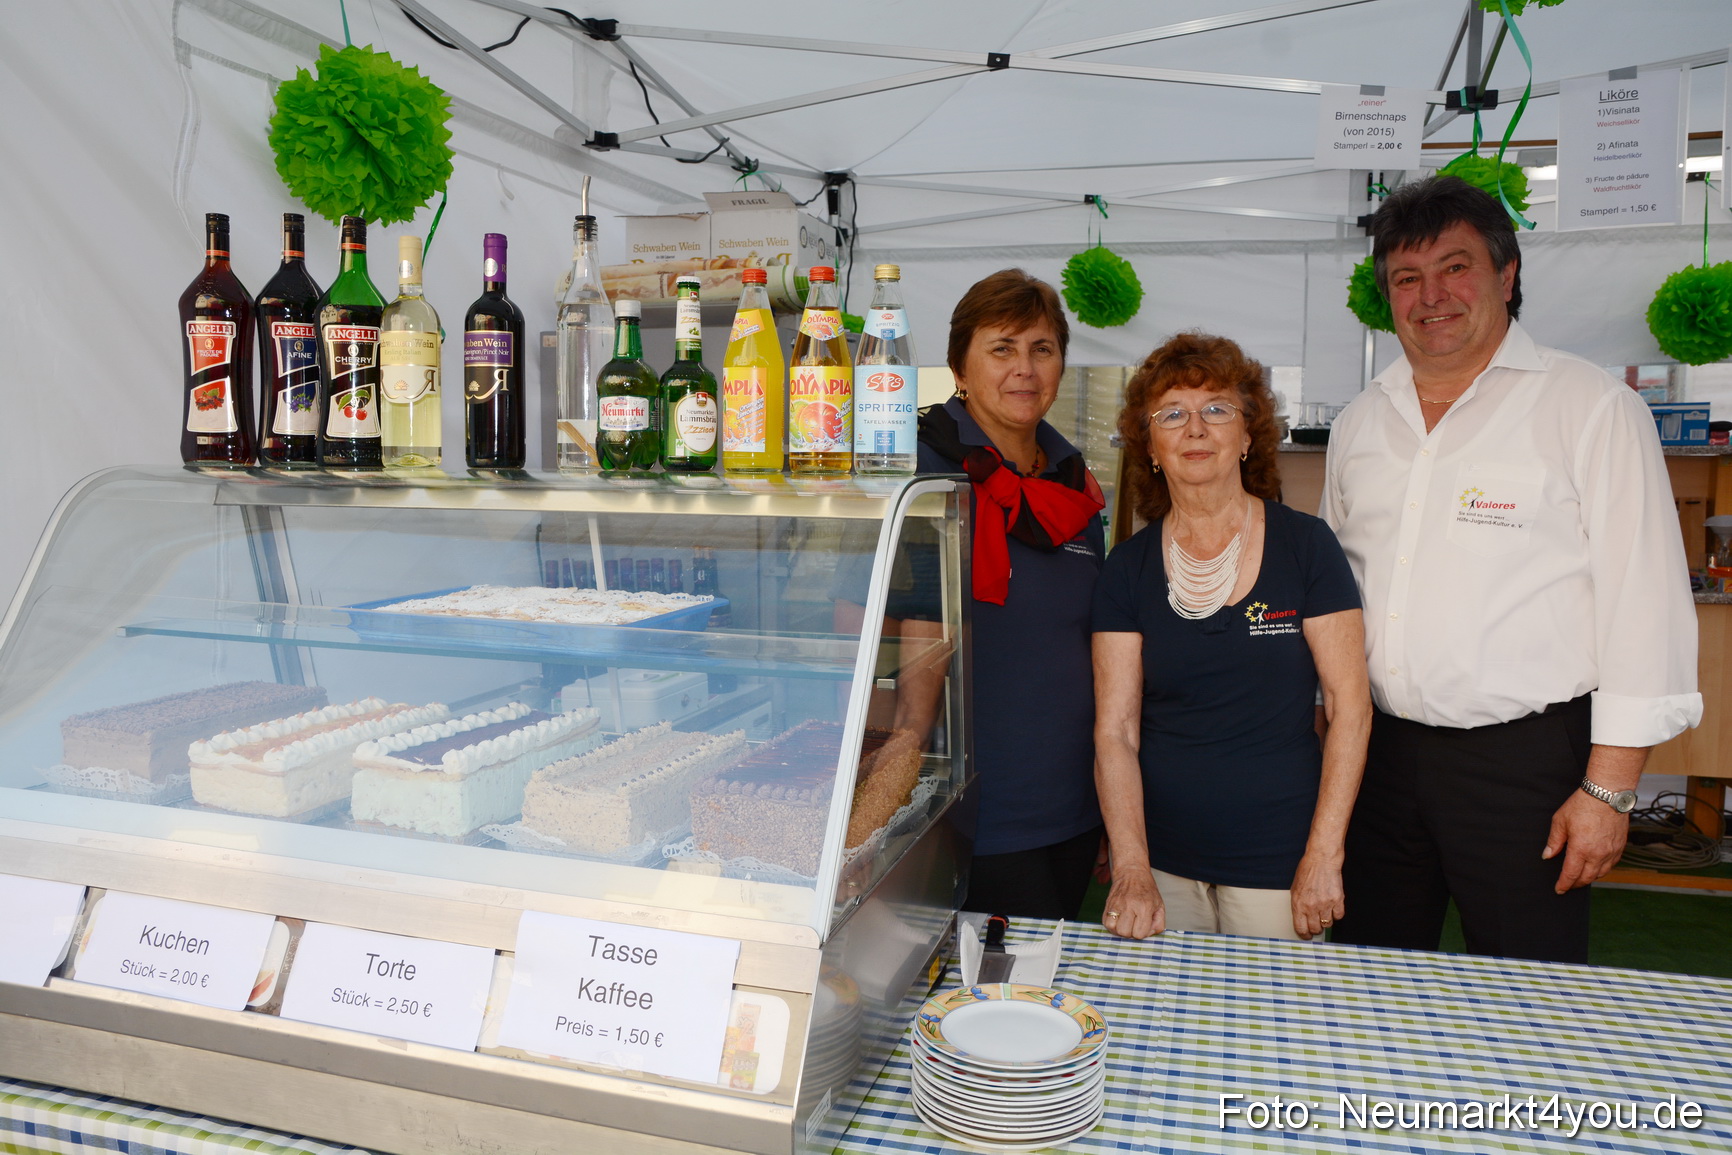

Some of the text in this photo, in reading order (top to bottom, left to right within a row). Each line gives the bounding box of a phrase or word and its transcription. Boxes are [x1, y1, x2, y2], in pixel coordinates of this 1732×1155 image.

[1599, 89, 1640, 102] Liköre
[1335, 111, 1407, 123] Birnenschnaps
[1596, 119, 1640, 128] Weichsellikör
[1343, 127, 1396, 138] (von 2015)
[1333, 142, 1368, 151] Stamperl
[1377, 142, 1395, 150] 2,00
[1396, 142, 1403, 150] €
[1597, 140, 1639, 151] 2) Afinata
[1593, 152, 1642, 162] Heidelbeerlikör
[1594, 175, 1615, 183] Fructe
[731, 198, 770, 206] FRAGIL
[1580, 206, 1619, 217] Stamperl
[1630, 204, 1649, 213] 1,50
[1651, 203, 1657, 211] €
[633, 241, 701, 253] Schwaben Wein
[719, 237, 790, 249] Schwaben Wein
[806, 313, 839, 325] OLYMPIA
[189, 324, 233, 335] ANGELLI
[329, 329, 377, 340] ANGELLI
[483, 338, 508, 348] Wein
[334, 356, 372, 364] CHERRY
[789, 373, 852, 396] OLYMPIA
[601, 404, 645, 417] Neumarkt
[858, 404, 913, 413] SPRITZIG
[1475, 500, 1516, 510] Valores
[1456, 516, 1510, 527] Hilfe-Jugend-Kultur
[1263, 609, 1297, 621] Valores
[139, 924, 210, 956] Kuchen
[588, 934, 659, 967] Tasse
[366, 952, 417, 981] Torte
[120, 959, 210, 988] Stück = 2,00 €
[577, 977, 653, 1010] Kaffee
[331, 987, 433, 1018] Stück = 2,50 €
[555, 1015, 664, 1048] Preis = 1,50 €
